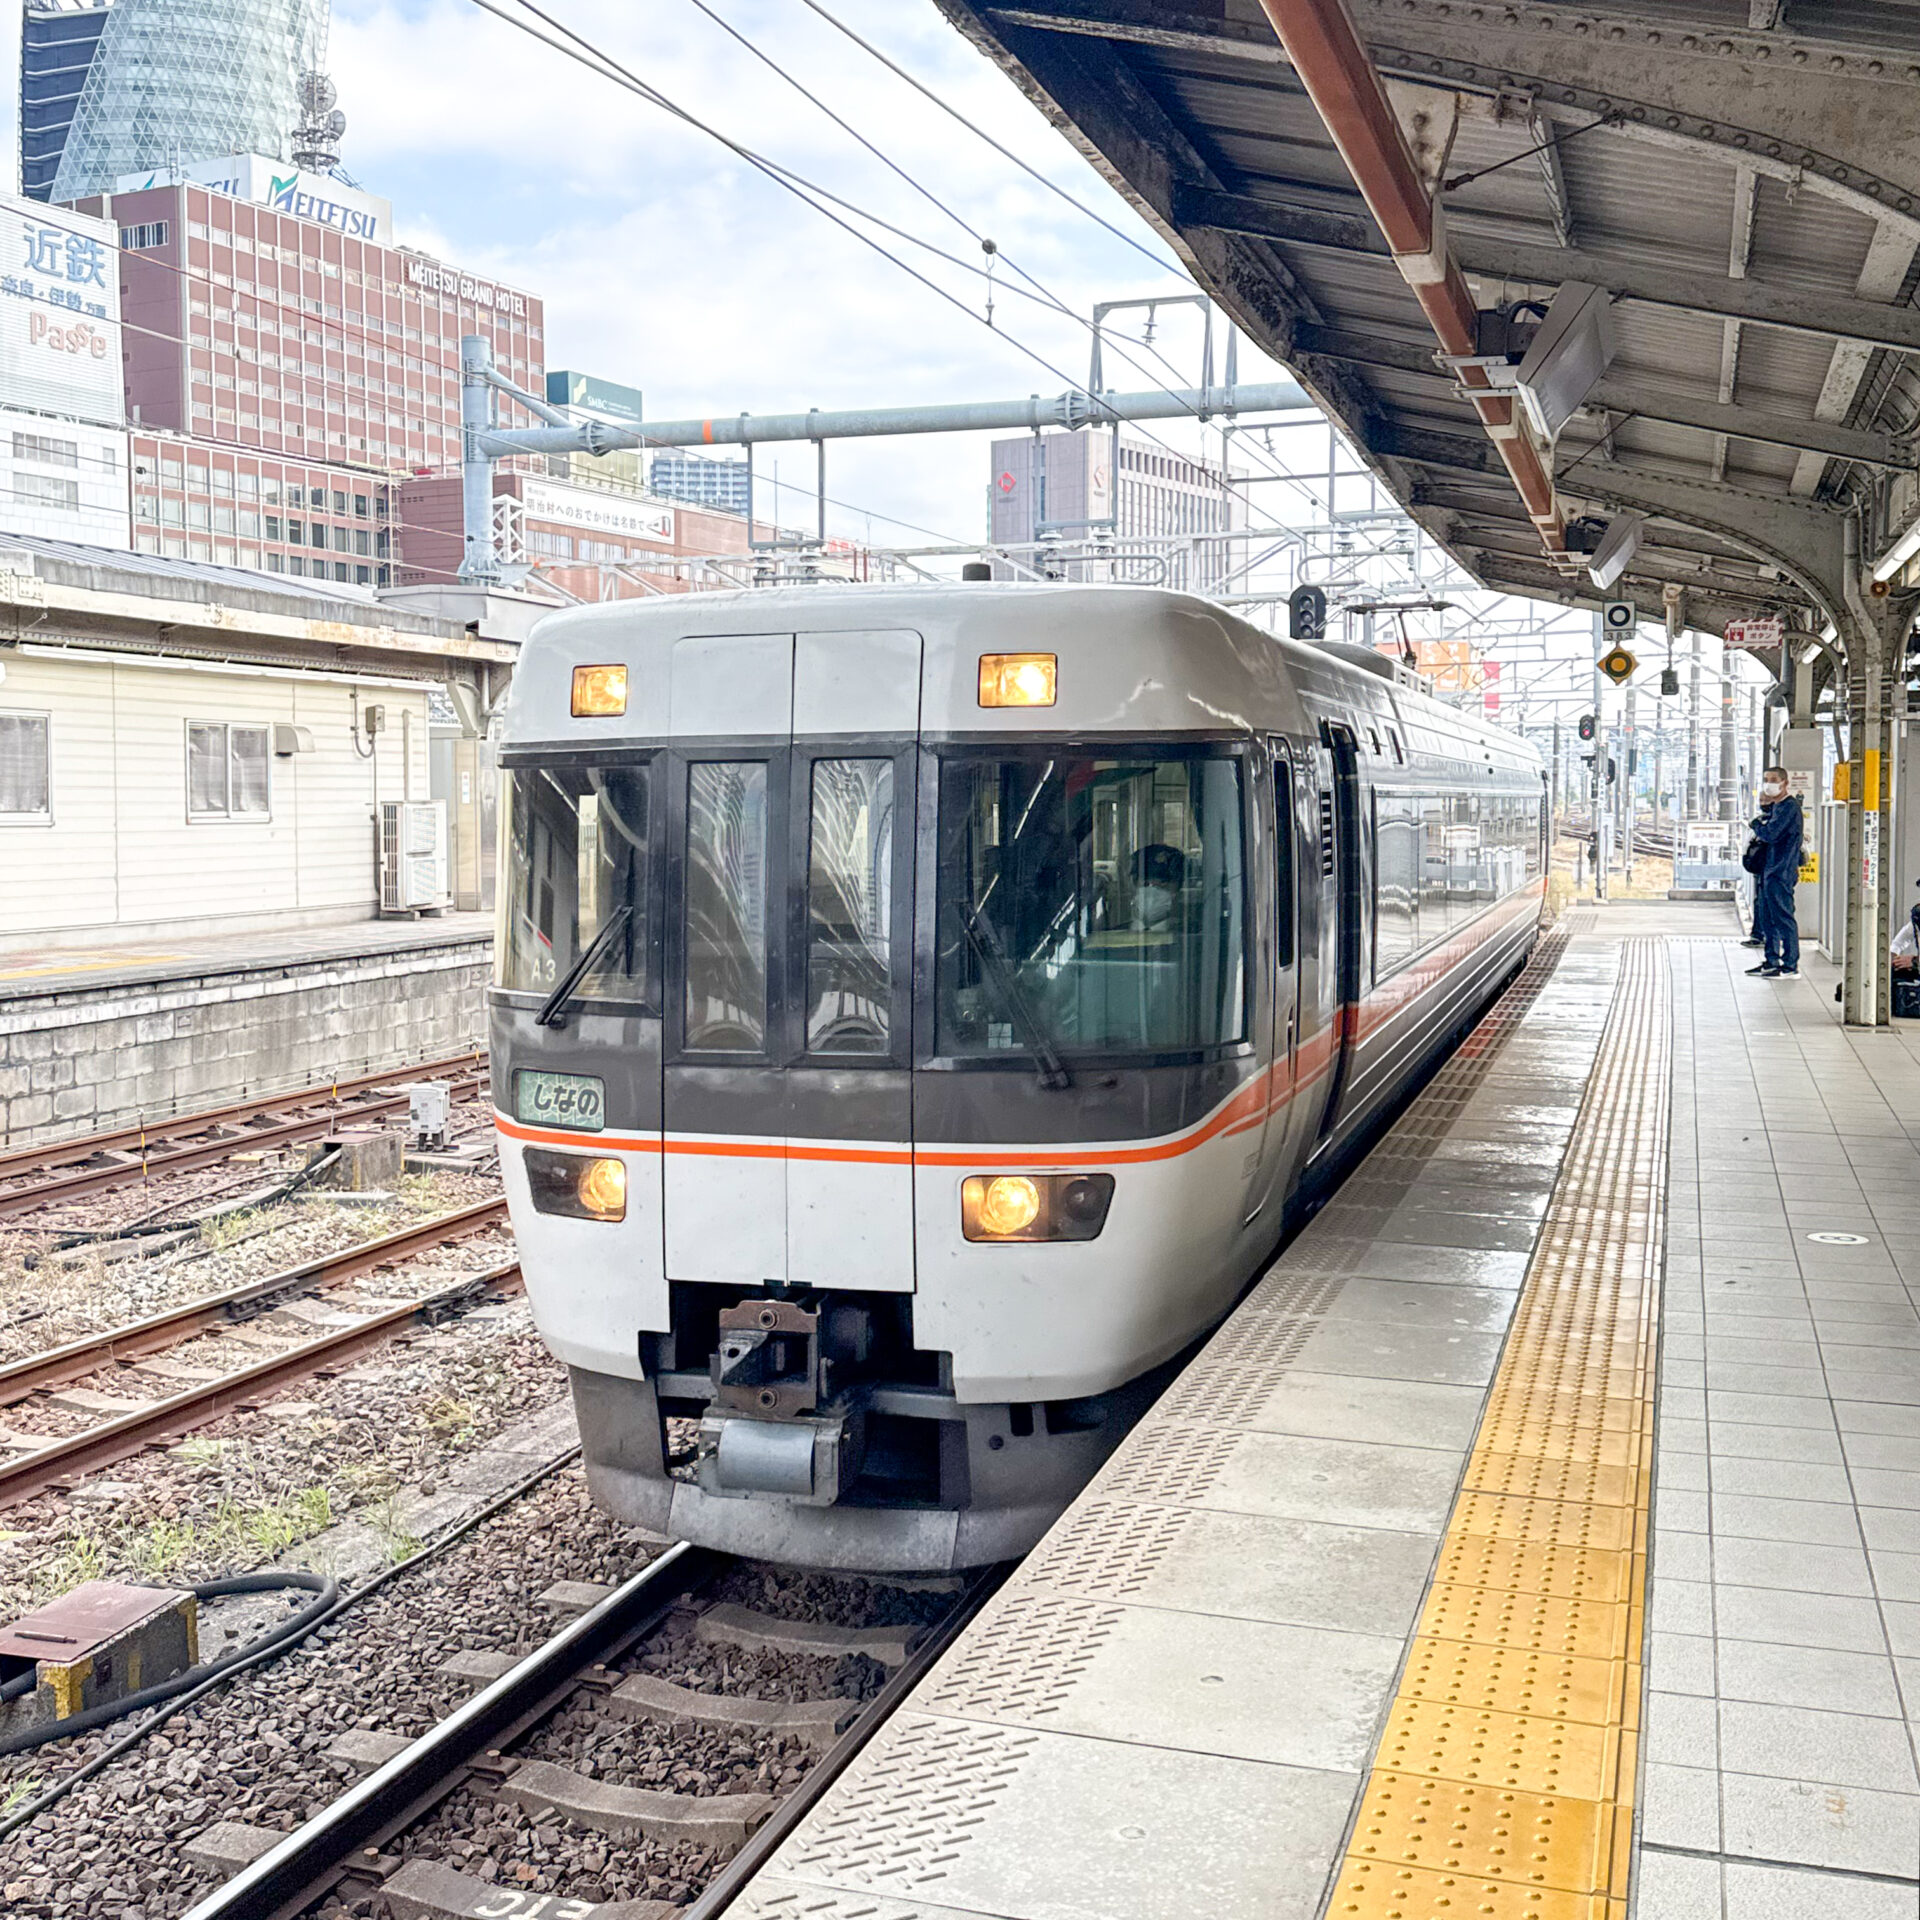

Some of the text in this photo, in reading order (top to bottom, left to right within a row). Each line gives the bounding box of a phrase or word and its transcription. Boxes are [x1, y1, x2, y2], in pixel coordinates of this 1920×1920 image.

[268, 172, 377, 240] MEITETSU
[24, 222, 106, 288] 近鉄
[409, 262, 526, 316] MEITETSU GRAND HOTEL
[1607, 631, 1632, 641] 383
[534, 1083, 600, 1116] しなの
